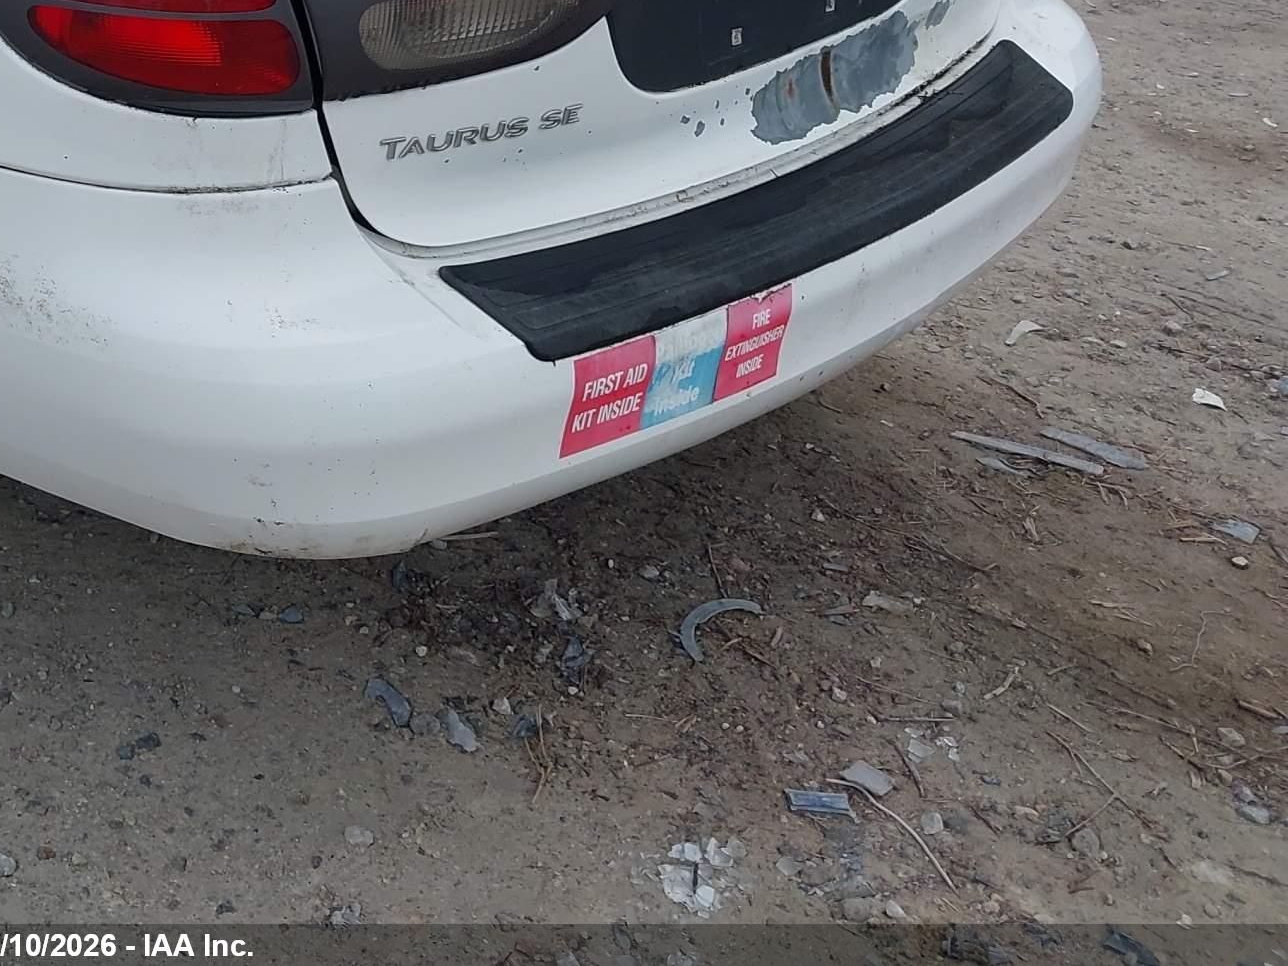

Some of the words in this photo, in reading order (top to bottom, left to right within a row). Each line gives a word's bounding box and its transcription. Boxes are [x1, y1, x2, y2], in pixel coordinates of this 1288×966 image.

[380, 116, 530, 161] TAURUS
[539, 103, 584, 130] SE
[752, 309, 771, 330] FIRE
[725, 324, 785, 361] EXTINGUISHER
[582, 371, 624, 402] FIRST
[623, 363, 648, 388] AID
[736, 354, 764, 378] INSIDE
[572, 409, 596, 433] KIT
[597, 392, 643, 424] INSIDE
